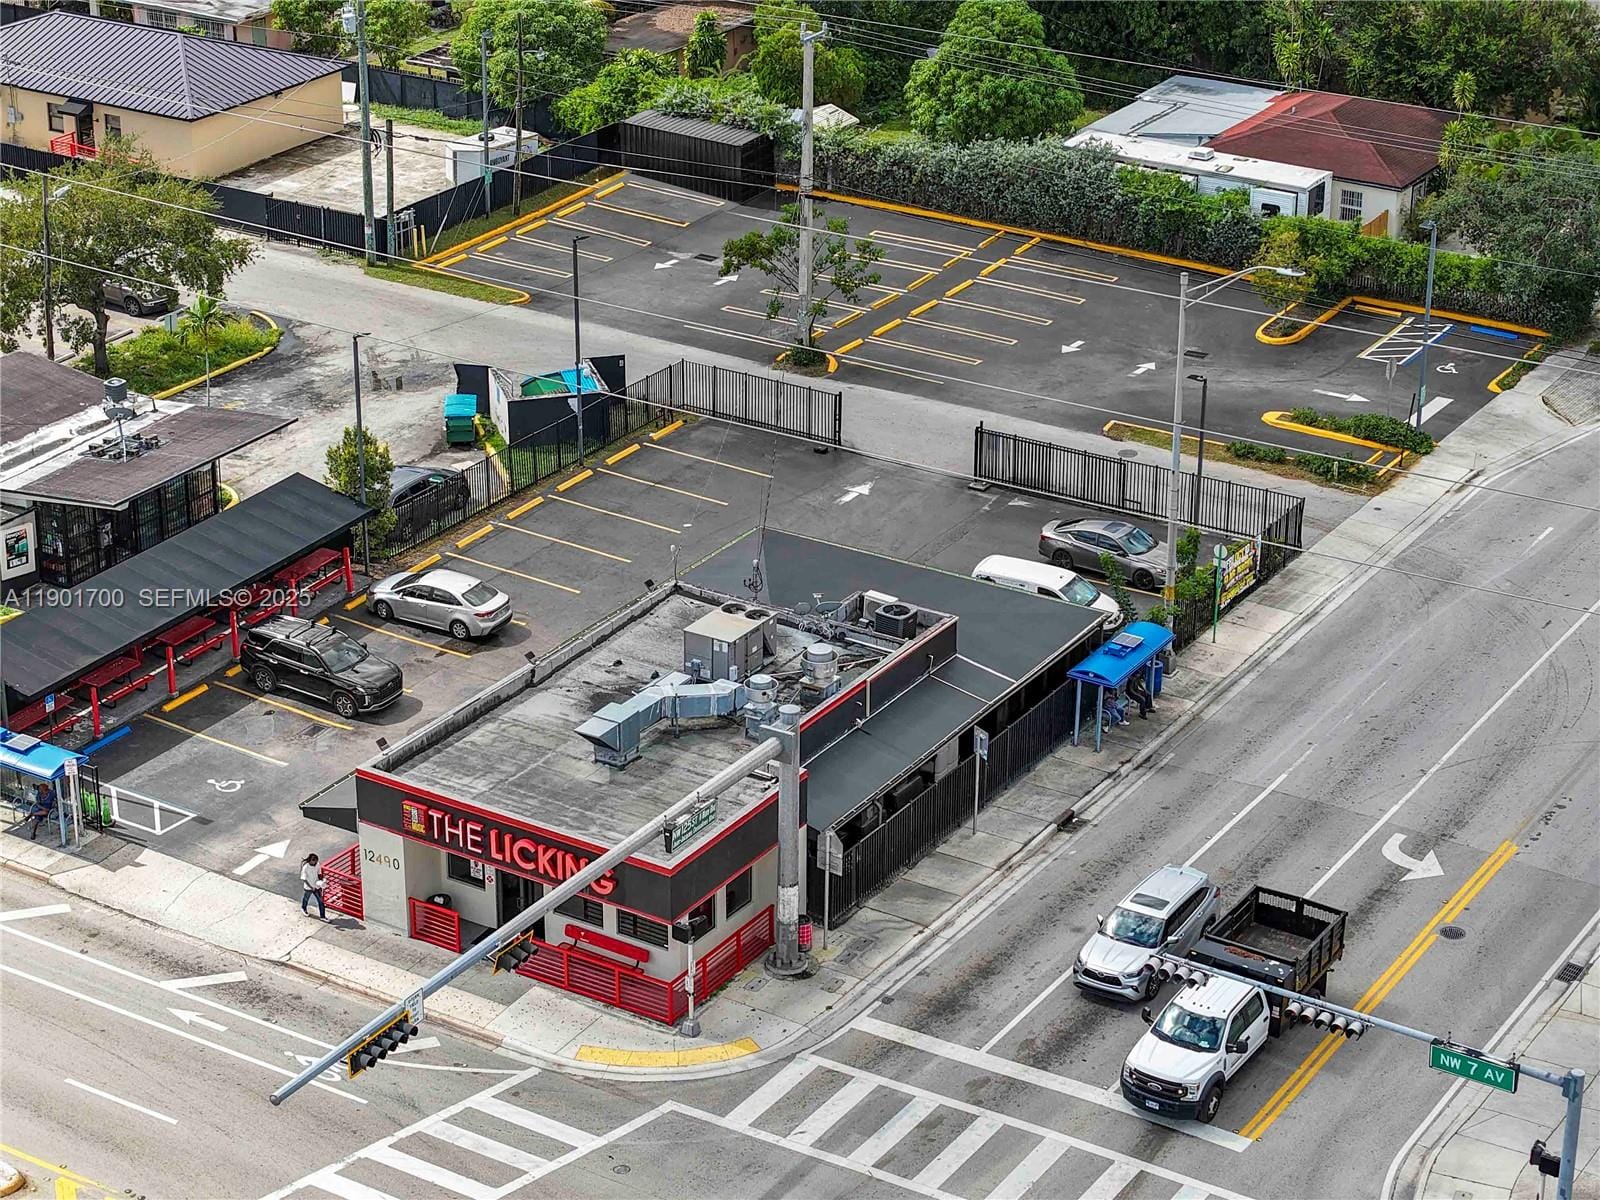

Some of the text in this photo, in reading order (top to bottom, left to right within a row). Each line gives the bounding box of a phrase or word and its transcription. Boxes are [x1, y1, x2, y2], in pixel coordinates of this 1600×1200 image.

[428, 809, 484, 853] THE
[364, 848, 400, 870] 12490
[1440, 1053, 1504, 1083] NW 7 AV
